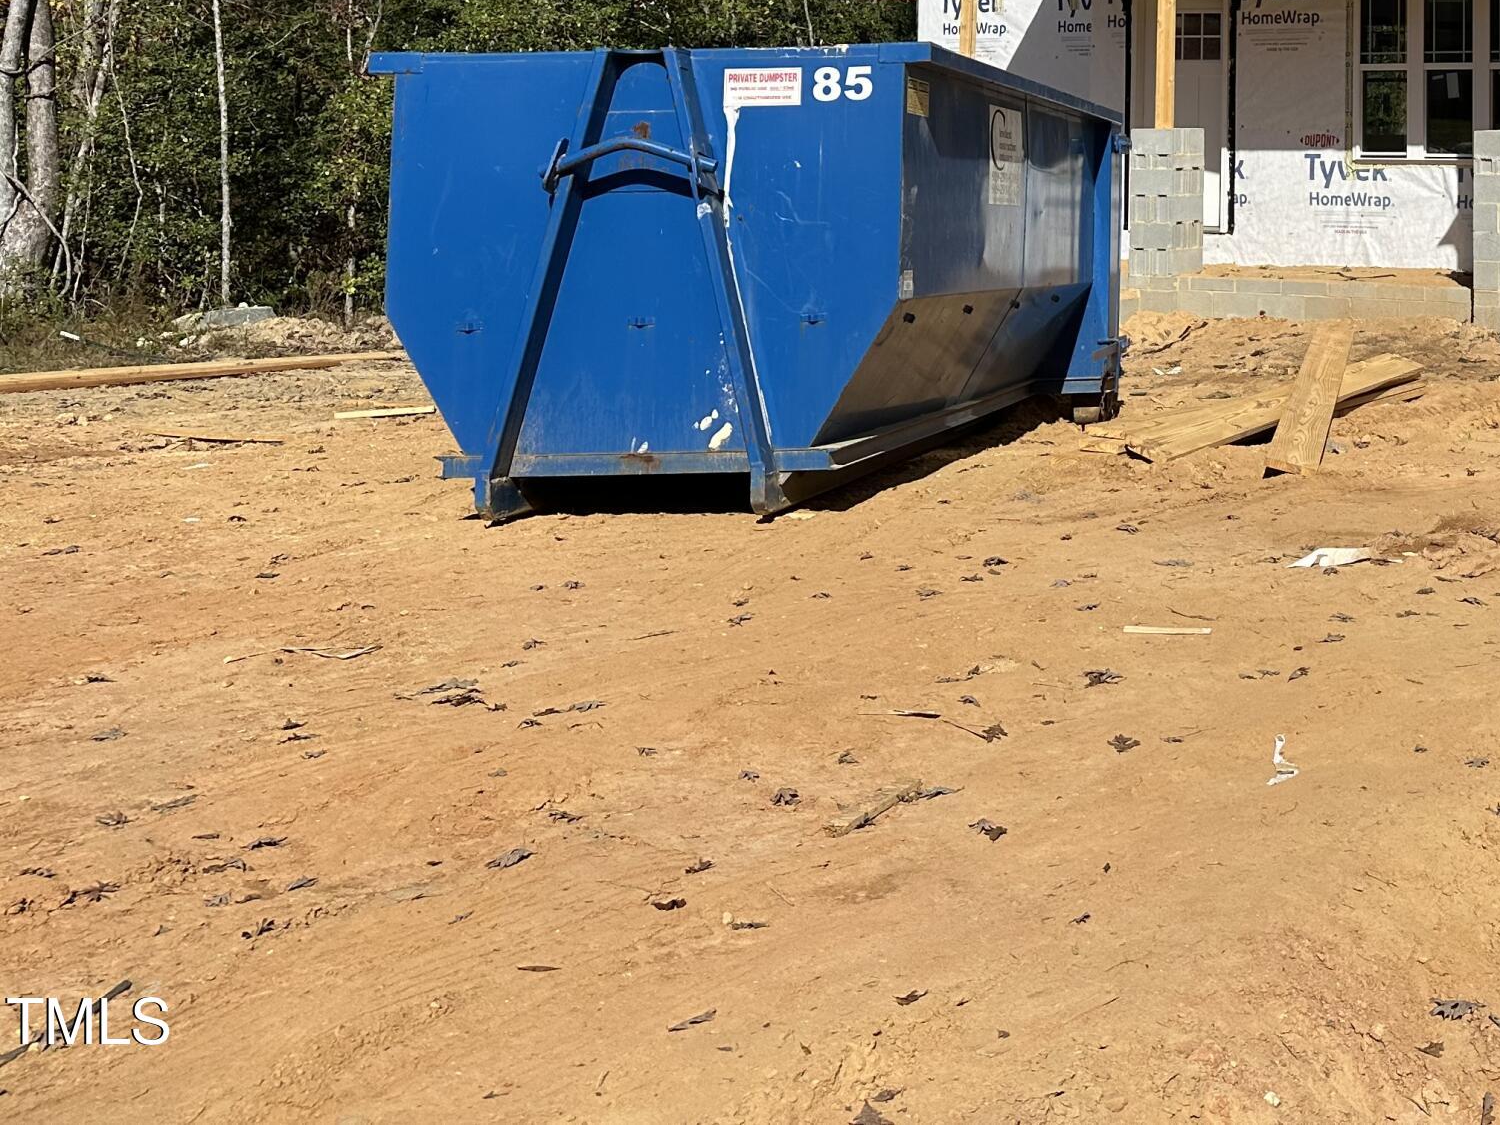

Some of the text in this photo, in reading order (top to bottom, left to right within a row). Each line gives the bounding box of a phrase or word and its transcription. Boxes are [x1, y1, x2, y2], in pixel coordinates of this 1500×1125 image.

[1241, 10, 1321, 26] HomeWrap
[728, 72, 798, 83] PRIVATE DUMPSTER
[812, 65, 874, 102] 85
[1304, 133, 1337, 148] DUPONT
[1309, 192, 1391, 210] HomeWrap
